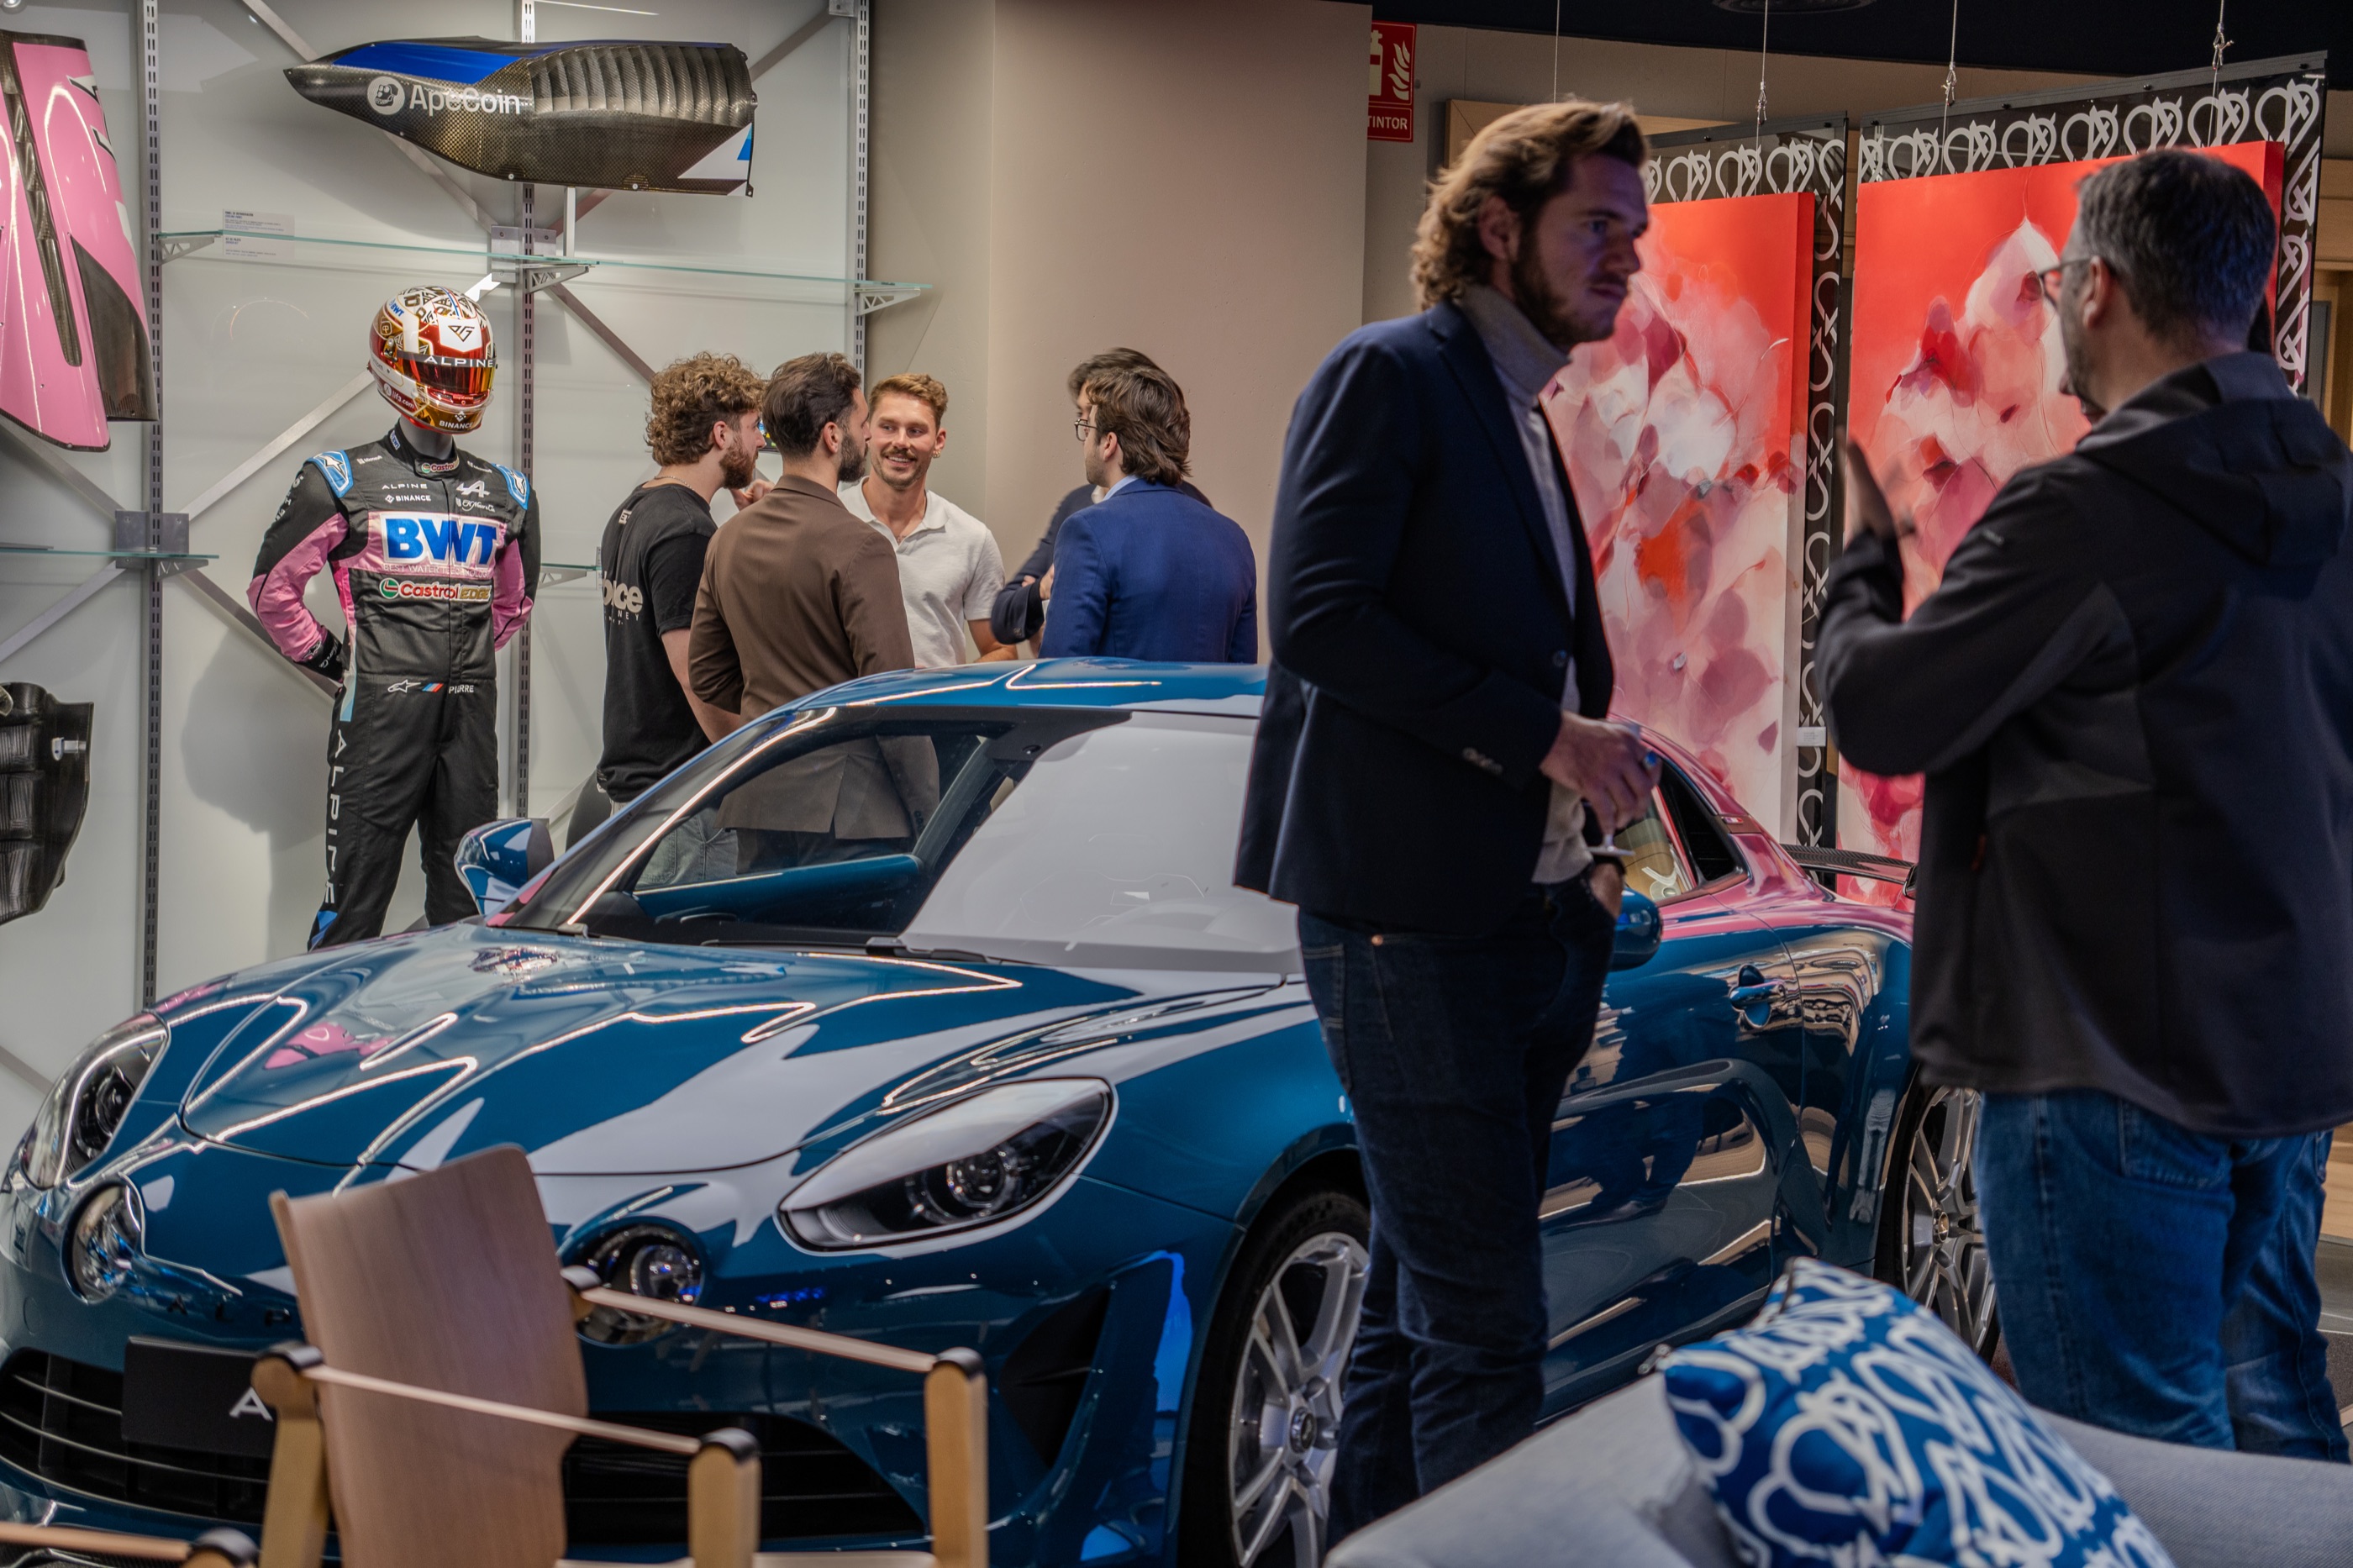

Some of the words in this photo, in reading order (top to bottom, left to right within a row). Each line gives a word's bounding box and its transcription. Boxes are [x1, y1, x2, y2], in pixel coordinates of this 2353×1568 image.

[409, 85, 521, 117] ApeCoin
[390, 304, 405, 318] BWT
[424, 355, 494, 368] ALPINE
[439, 420, 474, 429] BINANCE
[385, 518, 497, 565] BWT
[383, 564, 405, 572] BEST
[408, 565, 440, 573] WATER
[400, 583, 459, 599] Castrol
[461, 587, 491, 599] EDGE
